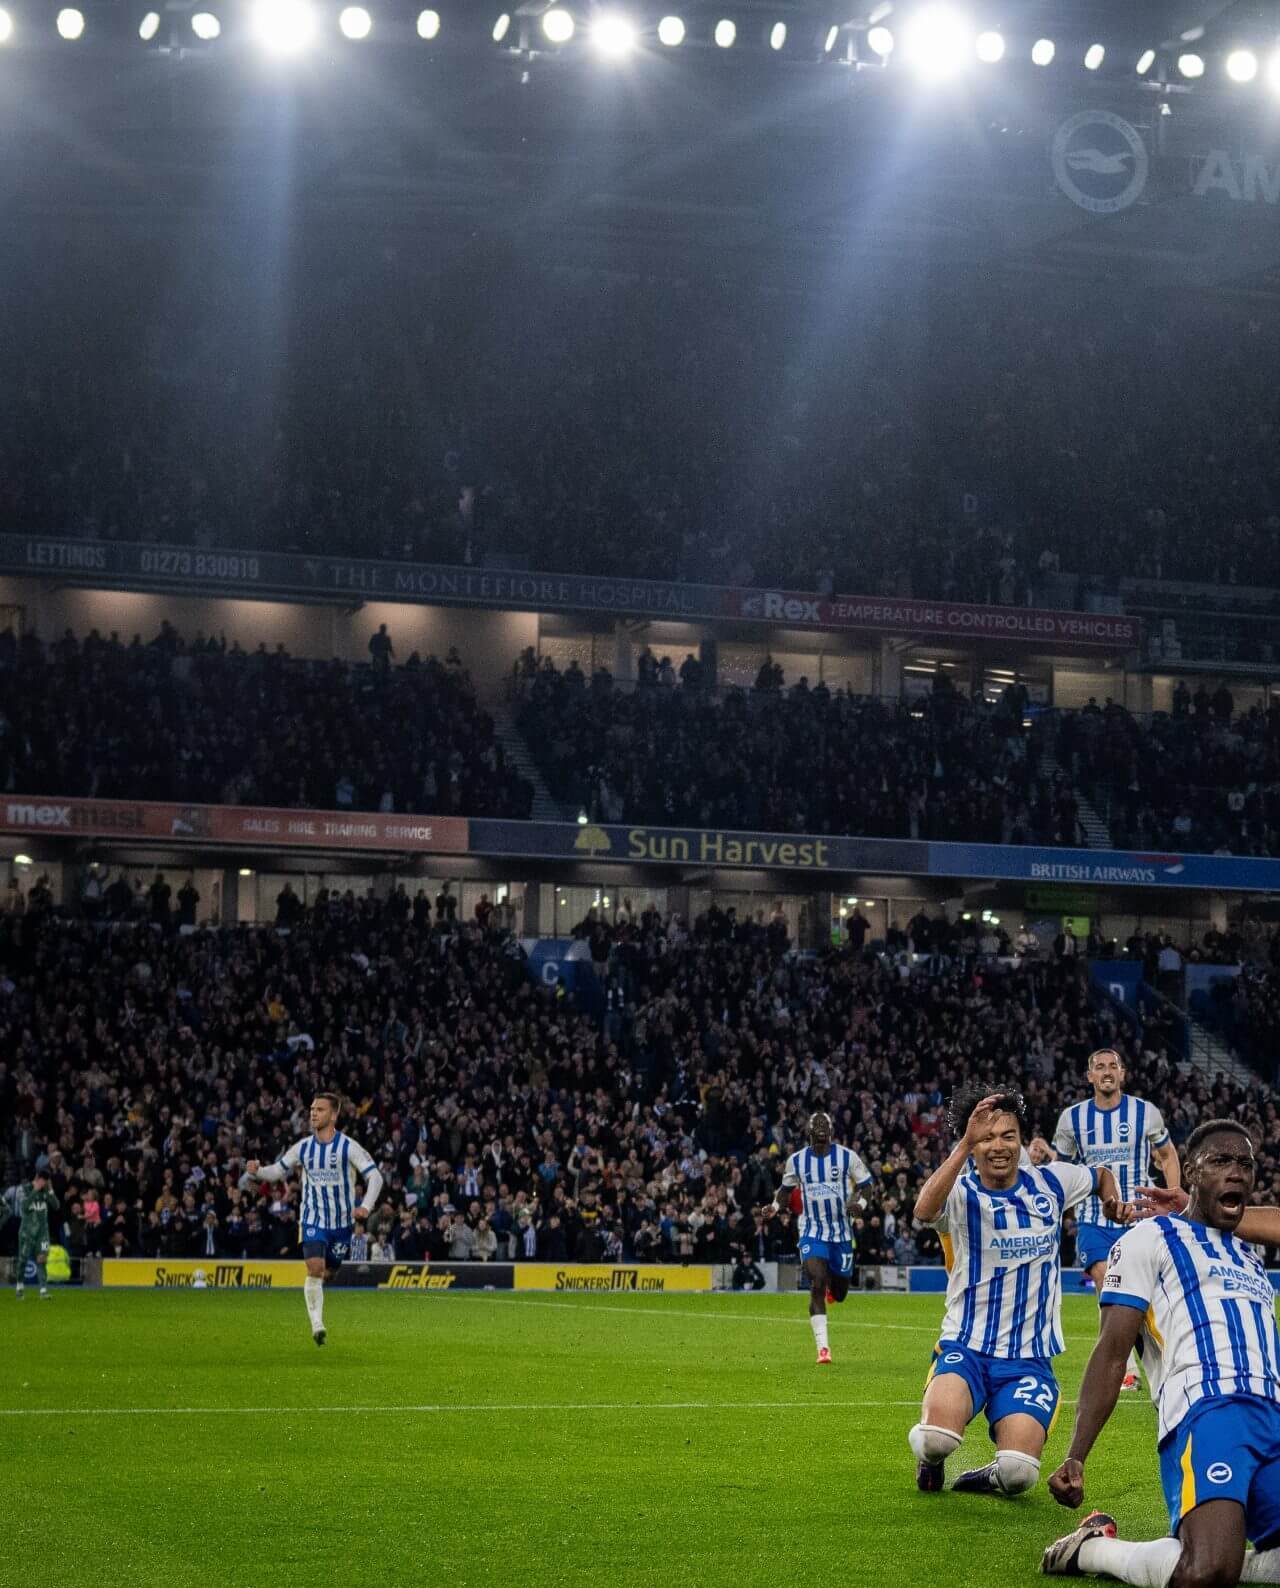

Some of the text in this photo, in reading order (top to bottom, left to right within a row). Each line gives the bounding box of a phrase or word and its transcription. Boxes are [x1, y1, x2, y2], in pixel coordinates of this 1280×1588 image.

[26, 543, 106, 569] LETTINGS
[140, 549, 190, 575] 01273
[331, 565, 696, 609] THE MONTEFIORE HOSPITAL
[765, 593, 1133, 638] Rex TEMPERATURE CONTROLLED VEHICLES
[385, 825, 432, 841] SERVICE
[628, 830, 828, 867] Sun Harvest
[1031, 863, 1156, 882] BRITISH AIRWAYS
[989, 1232, 1056, 1249] AMERICAN
[841, 1253, 853, 1271] 17
[1013, 1375, 1053, 1413] 22
